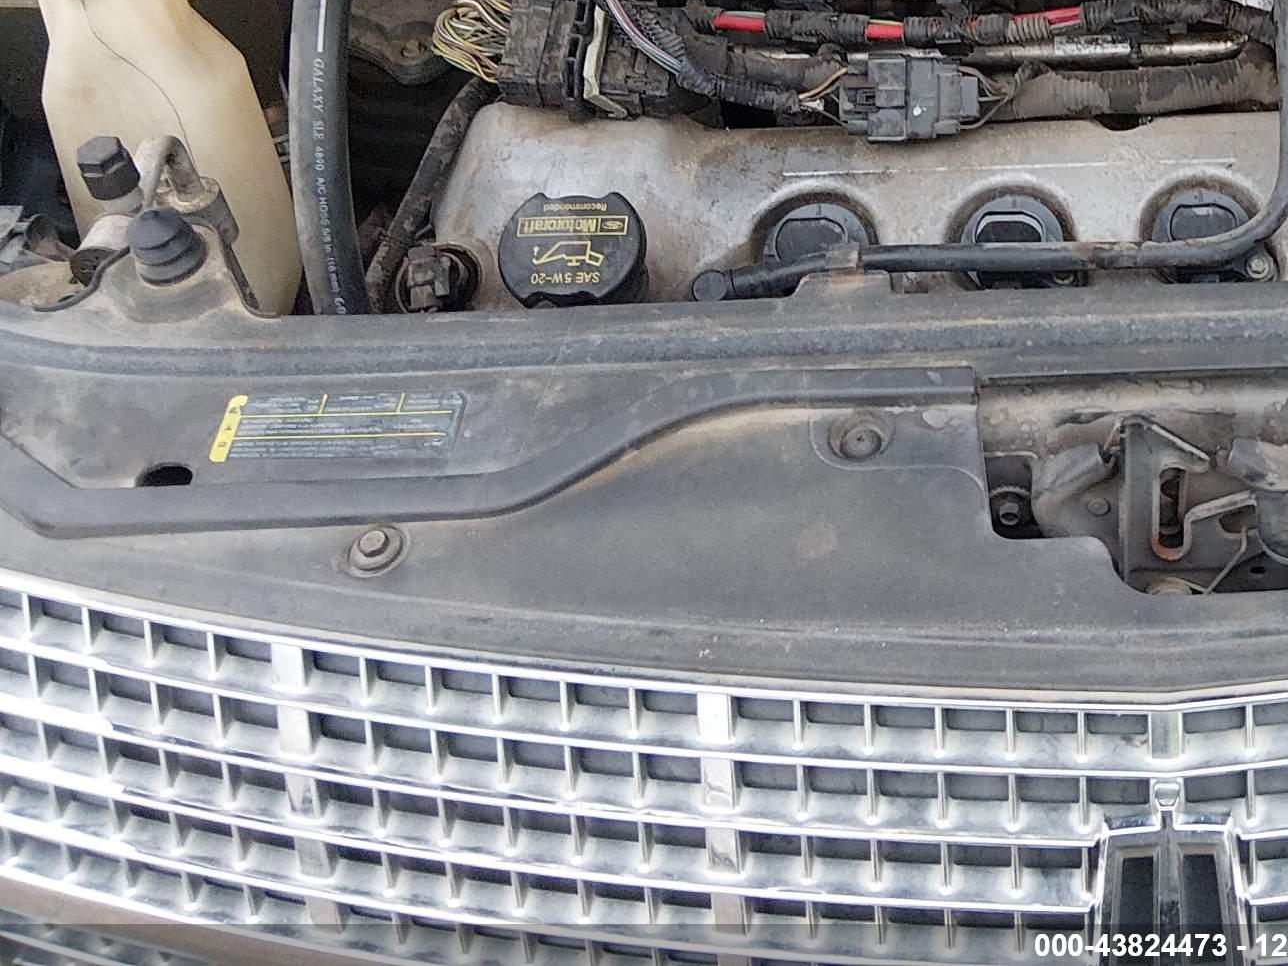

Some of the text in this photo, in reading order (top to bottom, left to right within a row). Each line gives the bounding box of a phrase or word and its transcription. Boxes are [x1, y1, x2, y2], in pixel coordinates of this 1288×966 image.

[312, 58, 326, 113] GALAXY
[316, 177, 327, 195] A/C
[543, 202, 608, 213] Recommended
[524, 218, 597, 234] Motorcraft
[530, 271, 601, 285] SAE 5W-20
